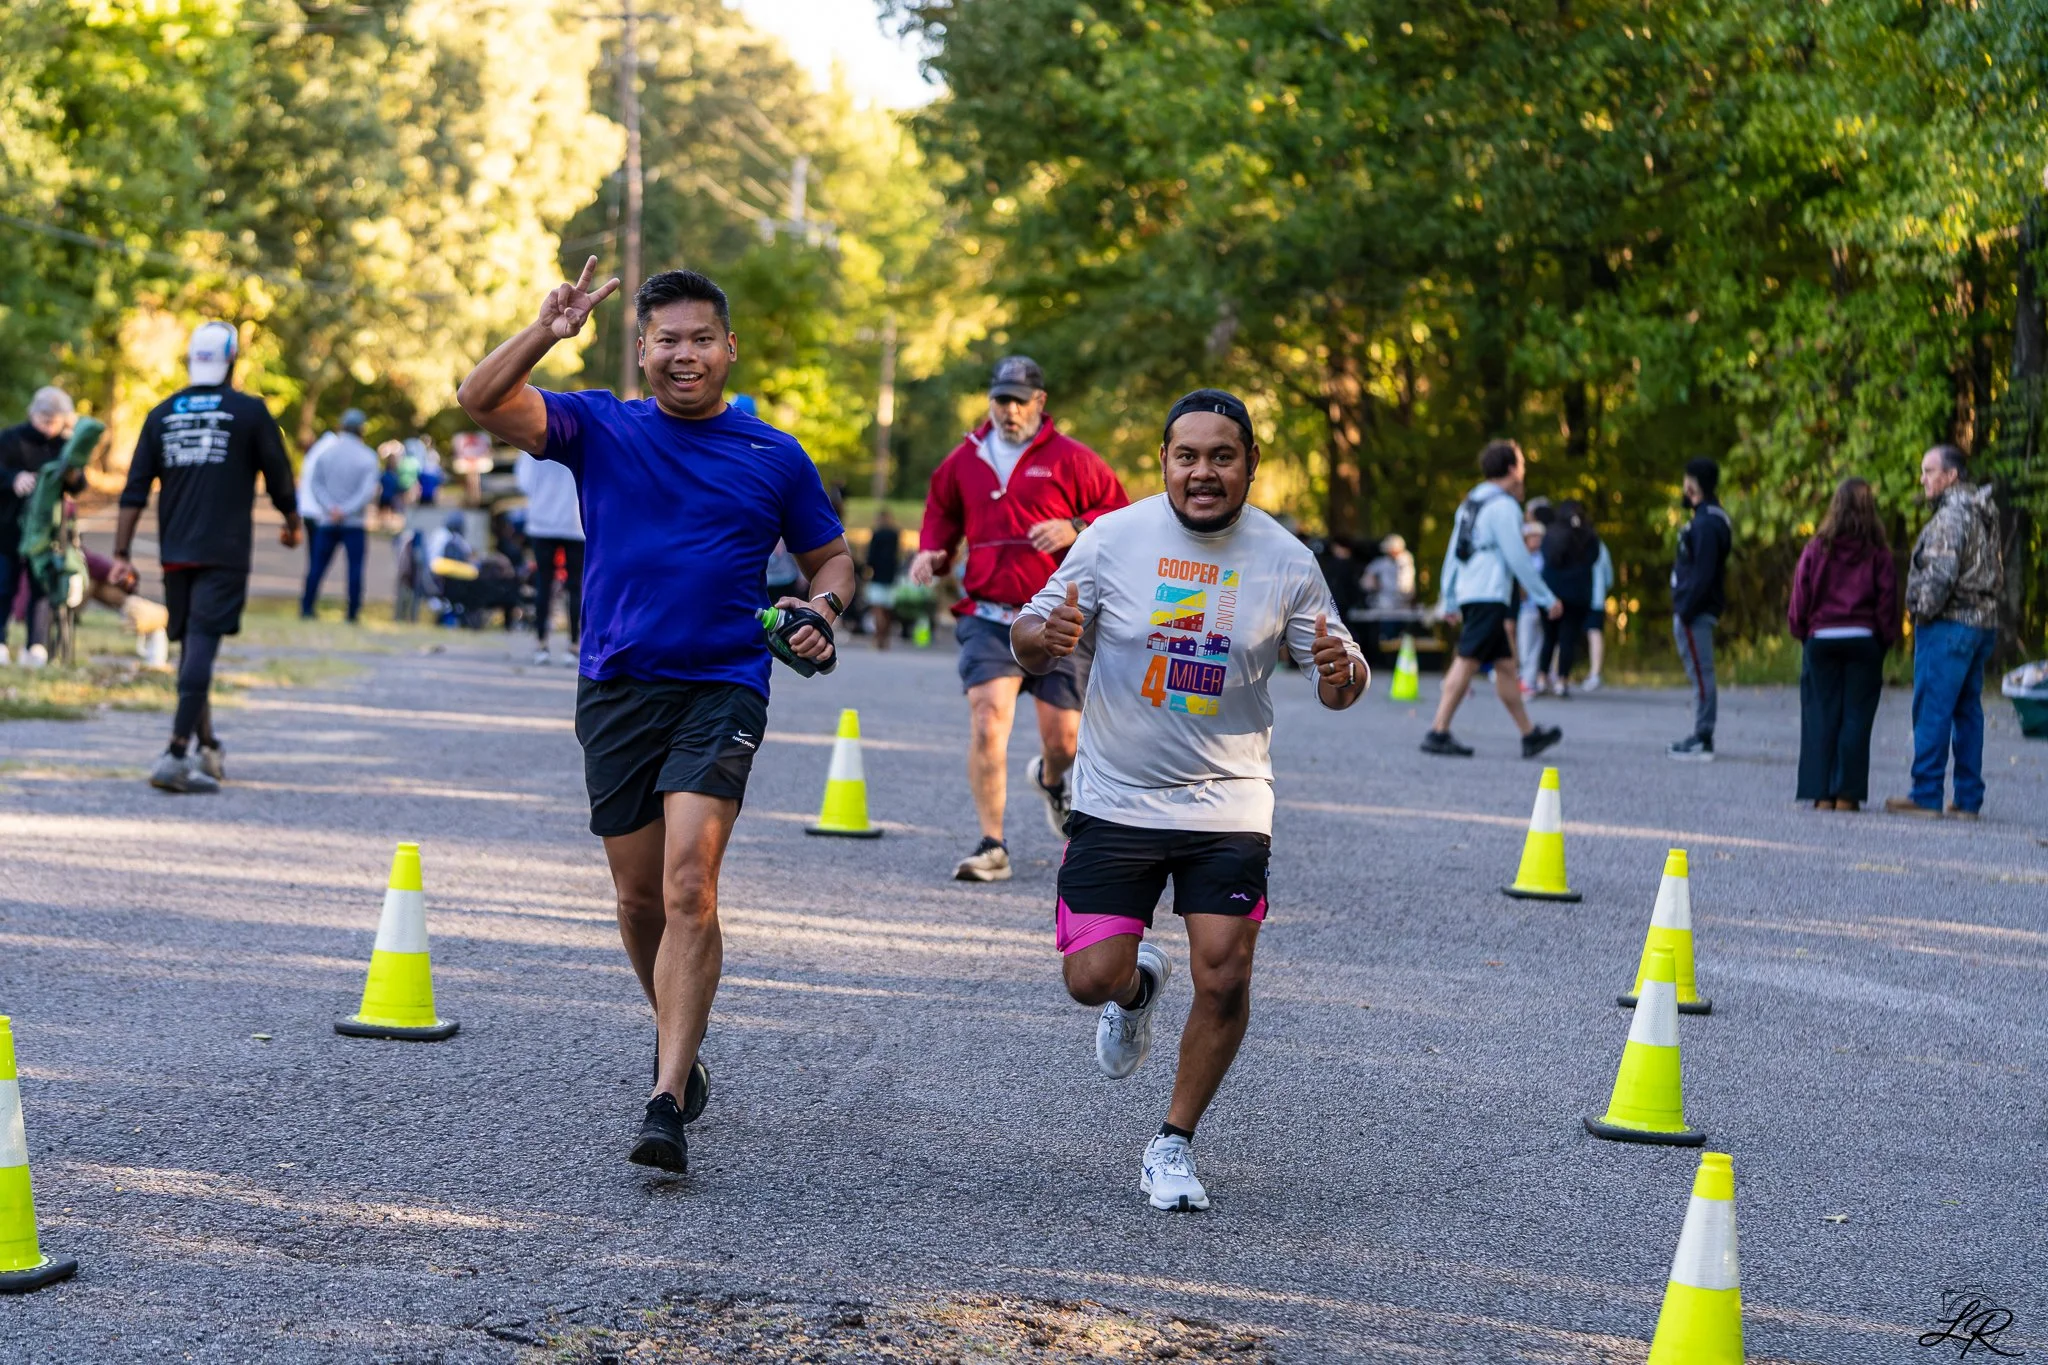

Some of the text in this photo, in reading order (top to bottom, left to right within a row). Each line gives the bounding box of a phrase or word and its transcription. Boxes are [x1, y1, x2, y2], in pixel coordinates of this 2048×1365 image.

[1158, 557, 1220, 585] COOPER
[1215, 590, 1237, 632] YOUNG
[1141, 654, 1223, 707] 4 MILER
